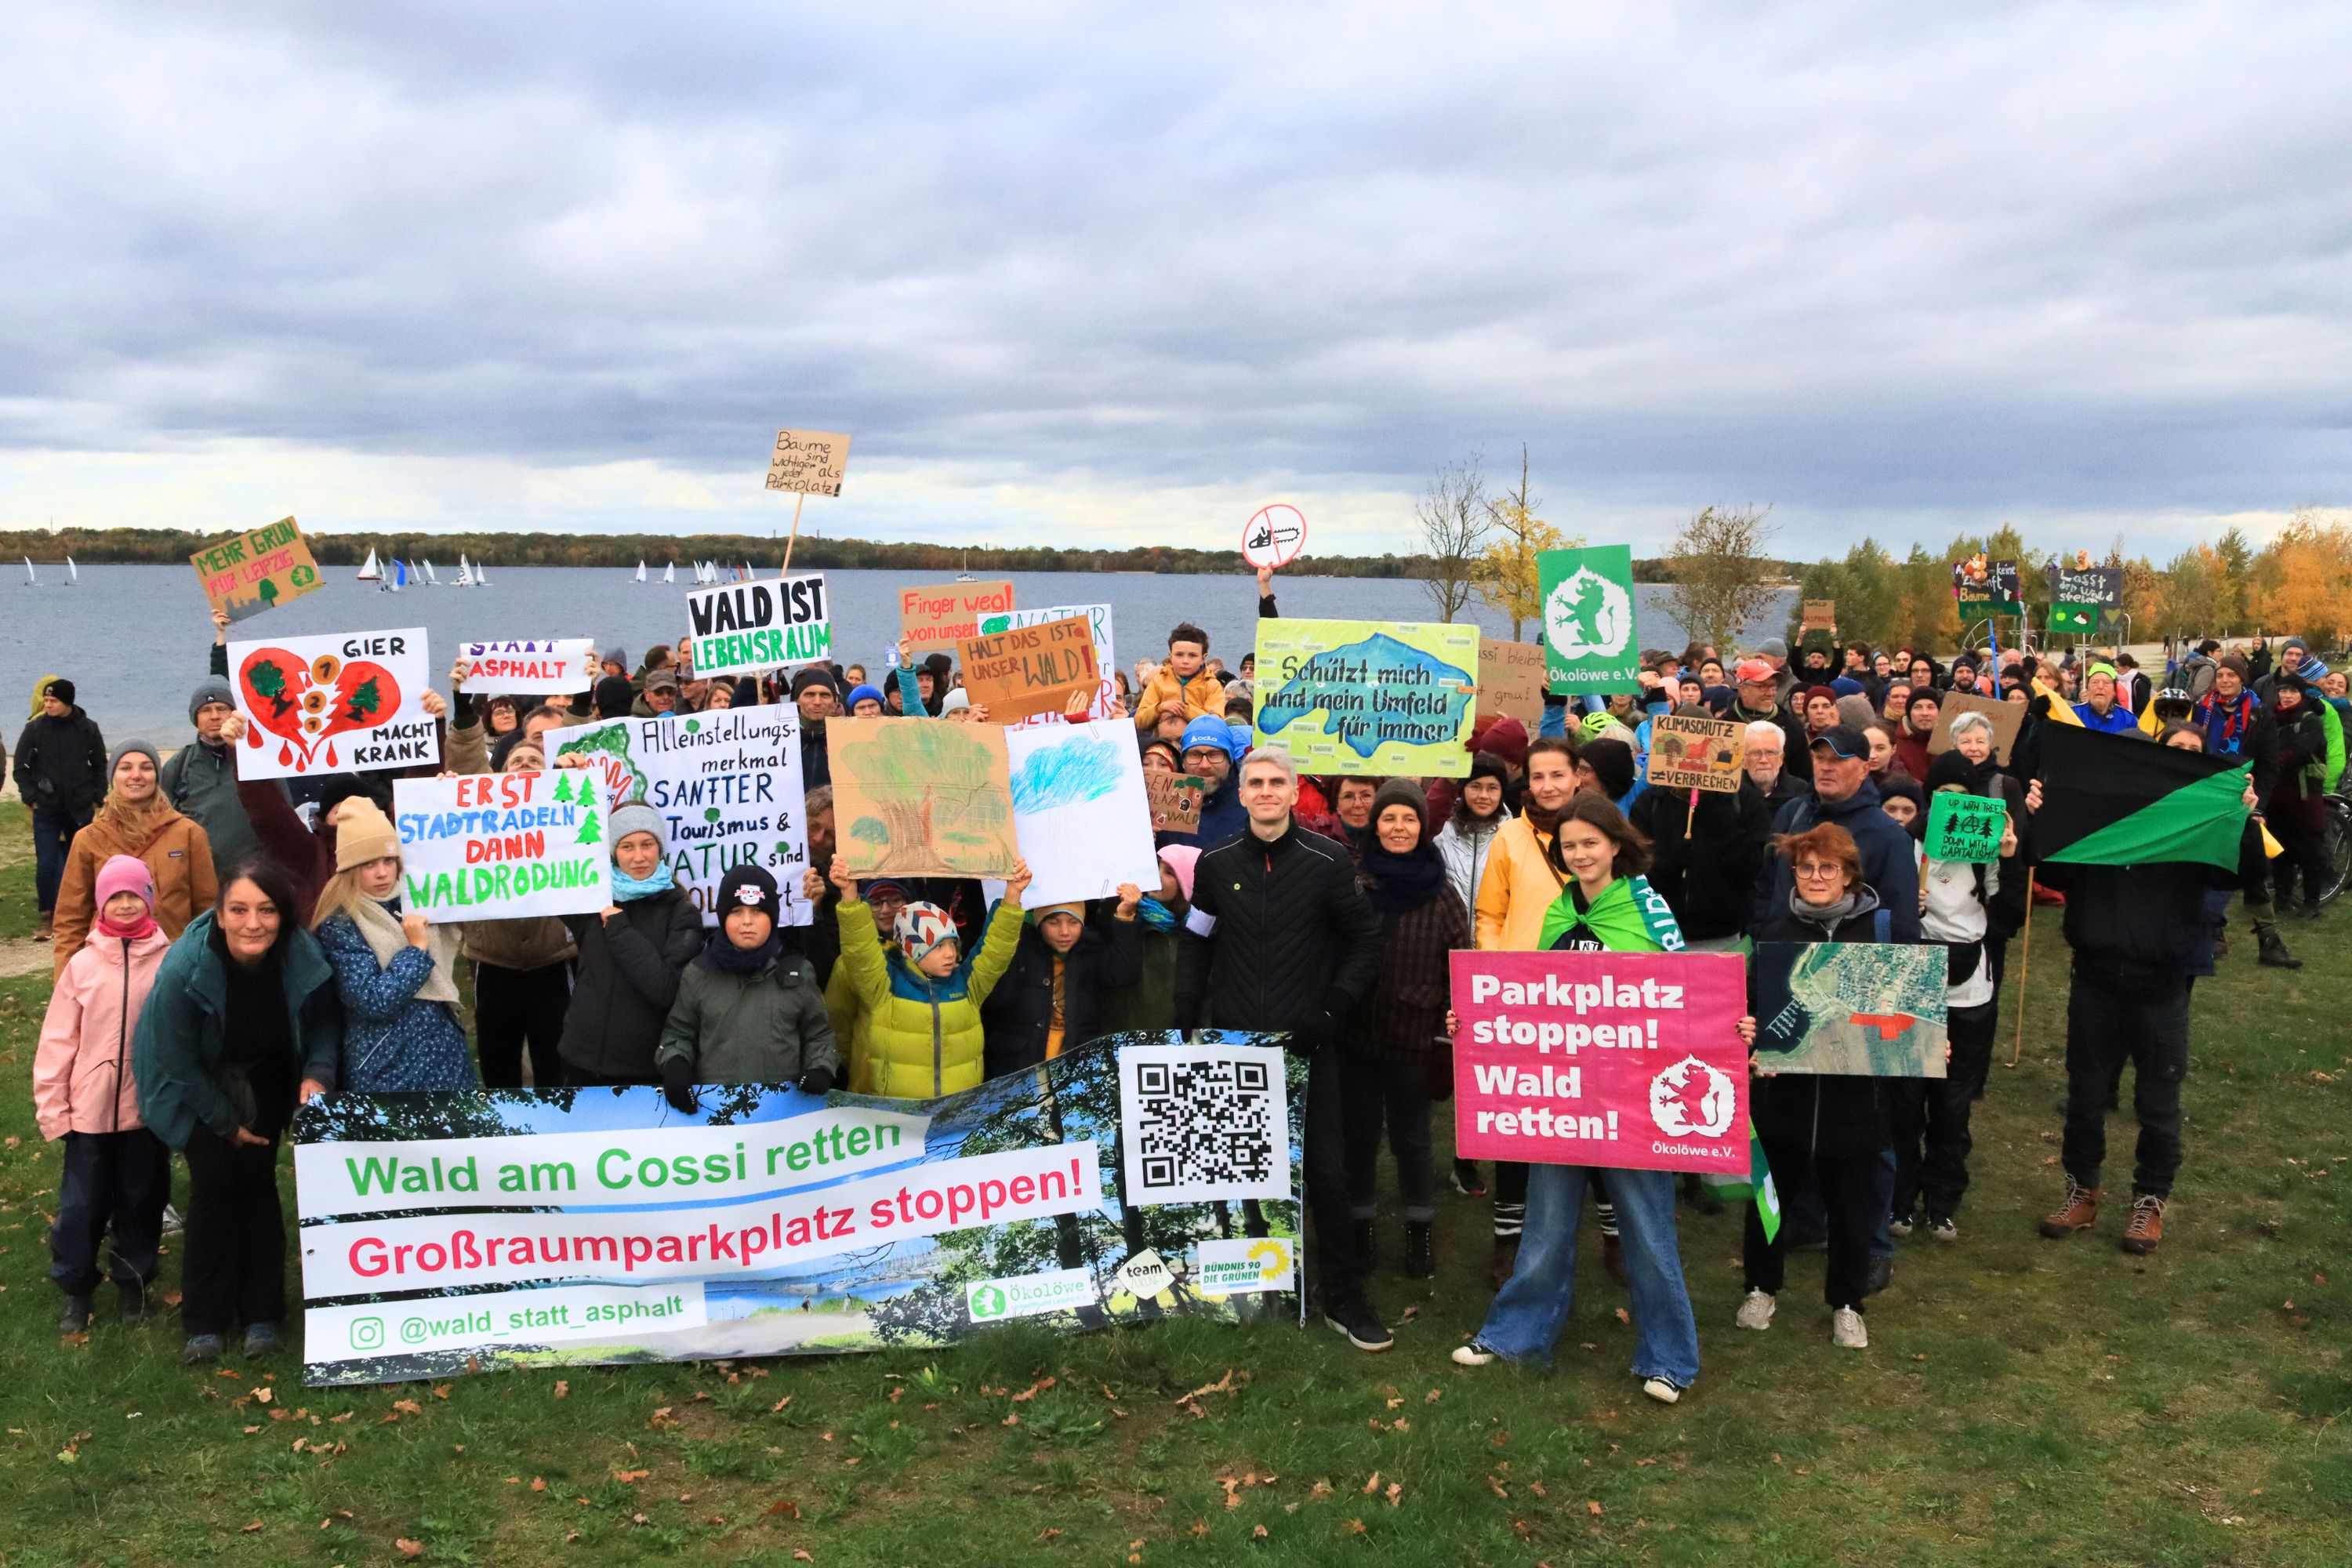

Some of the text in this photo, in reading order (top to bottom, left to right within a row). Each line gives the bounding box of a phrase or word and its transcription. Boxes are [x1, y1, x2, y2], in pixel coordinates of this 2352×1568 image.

[777, 431, 831, 454] Bäume
[772, 456, 841, 478] wichtiger als
[805, 452, 829, 464] sind
[765, 473, 841, 498] Parkplatz!
[196, 539, 248, 577] MEHR
[241, 549, 295, 584] LEIPZIG
[1996, 561, 2016, 576] keine
[2060, 568, 2107, 590] Lasst
[689, 578, 823, 637] WALD IST
[904, 584, 1013, 620] Finger weg!
[343, 637, 406, 658] GIER
[692, 622, 833, 672] LEBENSRAUM
[906, 626, 937, 641] von
[967, 636, 1005, 662] HALT
[1010, 630, 1041, 651] DAS
[1049, 622, 1076, 641] IST
[468, 659, 567, 679] ASPHALT
[971, 656, 1022, 681] UNSER
[1282, 655, 1431, 686] Schützt mich
[1549, 666, 1638, 682] Ökolöwe e.V.
[1265, 687, 1447, 720] und mein Umfeld
[372, 721, 434, 742] MACHT
[641, 714, 797, 753] Alleinstellungs-
[1338, 716, 1371, 744] für
[1657, 716, 1735, 738] KLIMASCHUTZ
[354, 740, 430, 764] KRANK
[701, 747, 787, 775] merkmal
[456, 771, 542, 810] ERST
[1167, 811, 1199, 825] WALD
[1948, 799, 2005, 815] UP WITH TREES
[397, 804, 575, 844] STADTRADELN
[666, 811, 791, 841] Tourismus &
[466, 829, 546, 864] DANN
[1940, 845, 1997, 861] CAPITALISM!
[1943, 835, 1988, 850] DOWN WITH
[666, 840, 804, 882] ATUR sind
[405, 857, 600, 909] WALDRODUNG
[1471, 974, 1684, 1015] Parkplatz
[1472, 1014, 1658, 1055] stoppen!
[1473, 1064, 1581, 1098] Wald
[1476, 1105, 1619, 1141] retten!
[345, 1124, 901, 1197] Wald am Cossi retten
[1651, 1140, 1737, 1158] Ökolöwe e.V.
[347, 1158, 1083, 1278] Großraumparkplatz stoppen!
[1127, 1263, 1162, 1278] team
[1203, 1270, 1260, 1283] DIE GRÜNEN
[1204, 1261, 1261, 1273] BÜNDNIS 90
[1010, 1280, 1085, 1301] Ökolöwe
[400, 1294, 684, 1345] @wald_statt_asphalt
